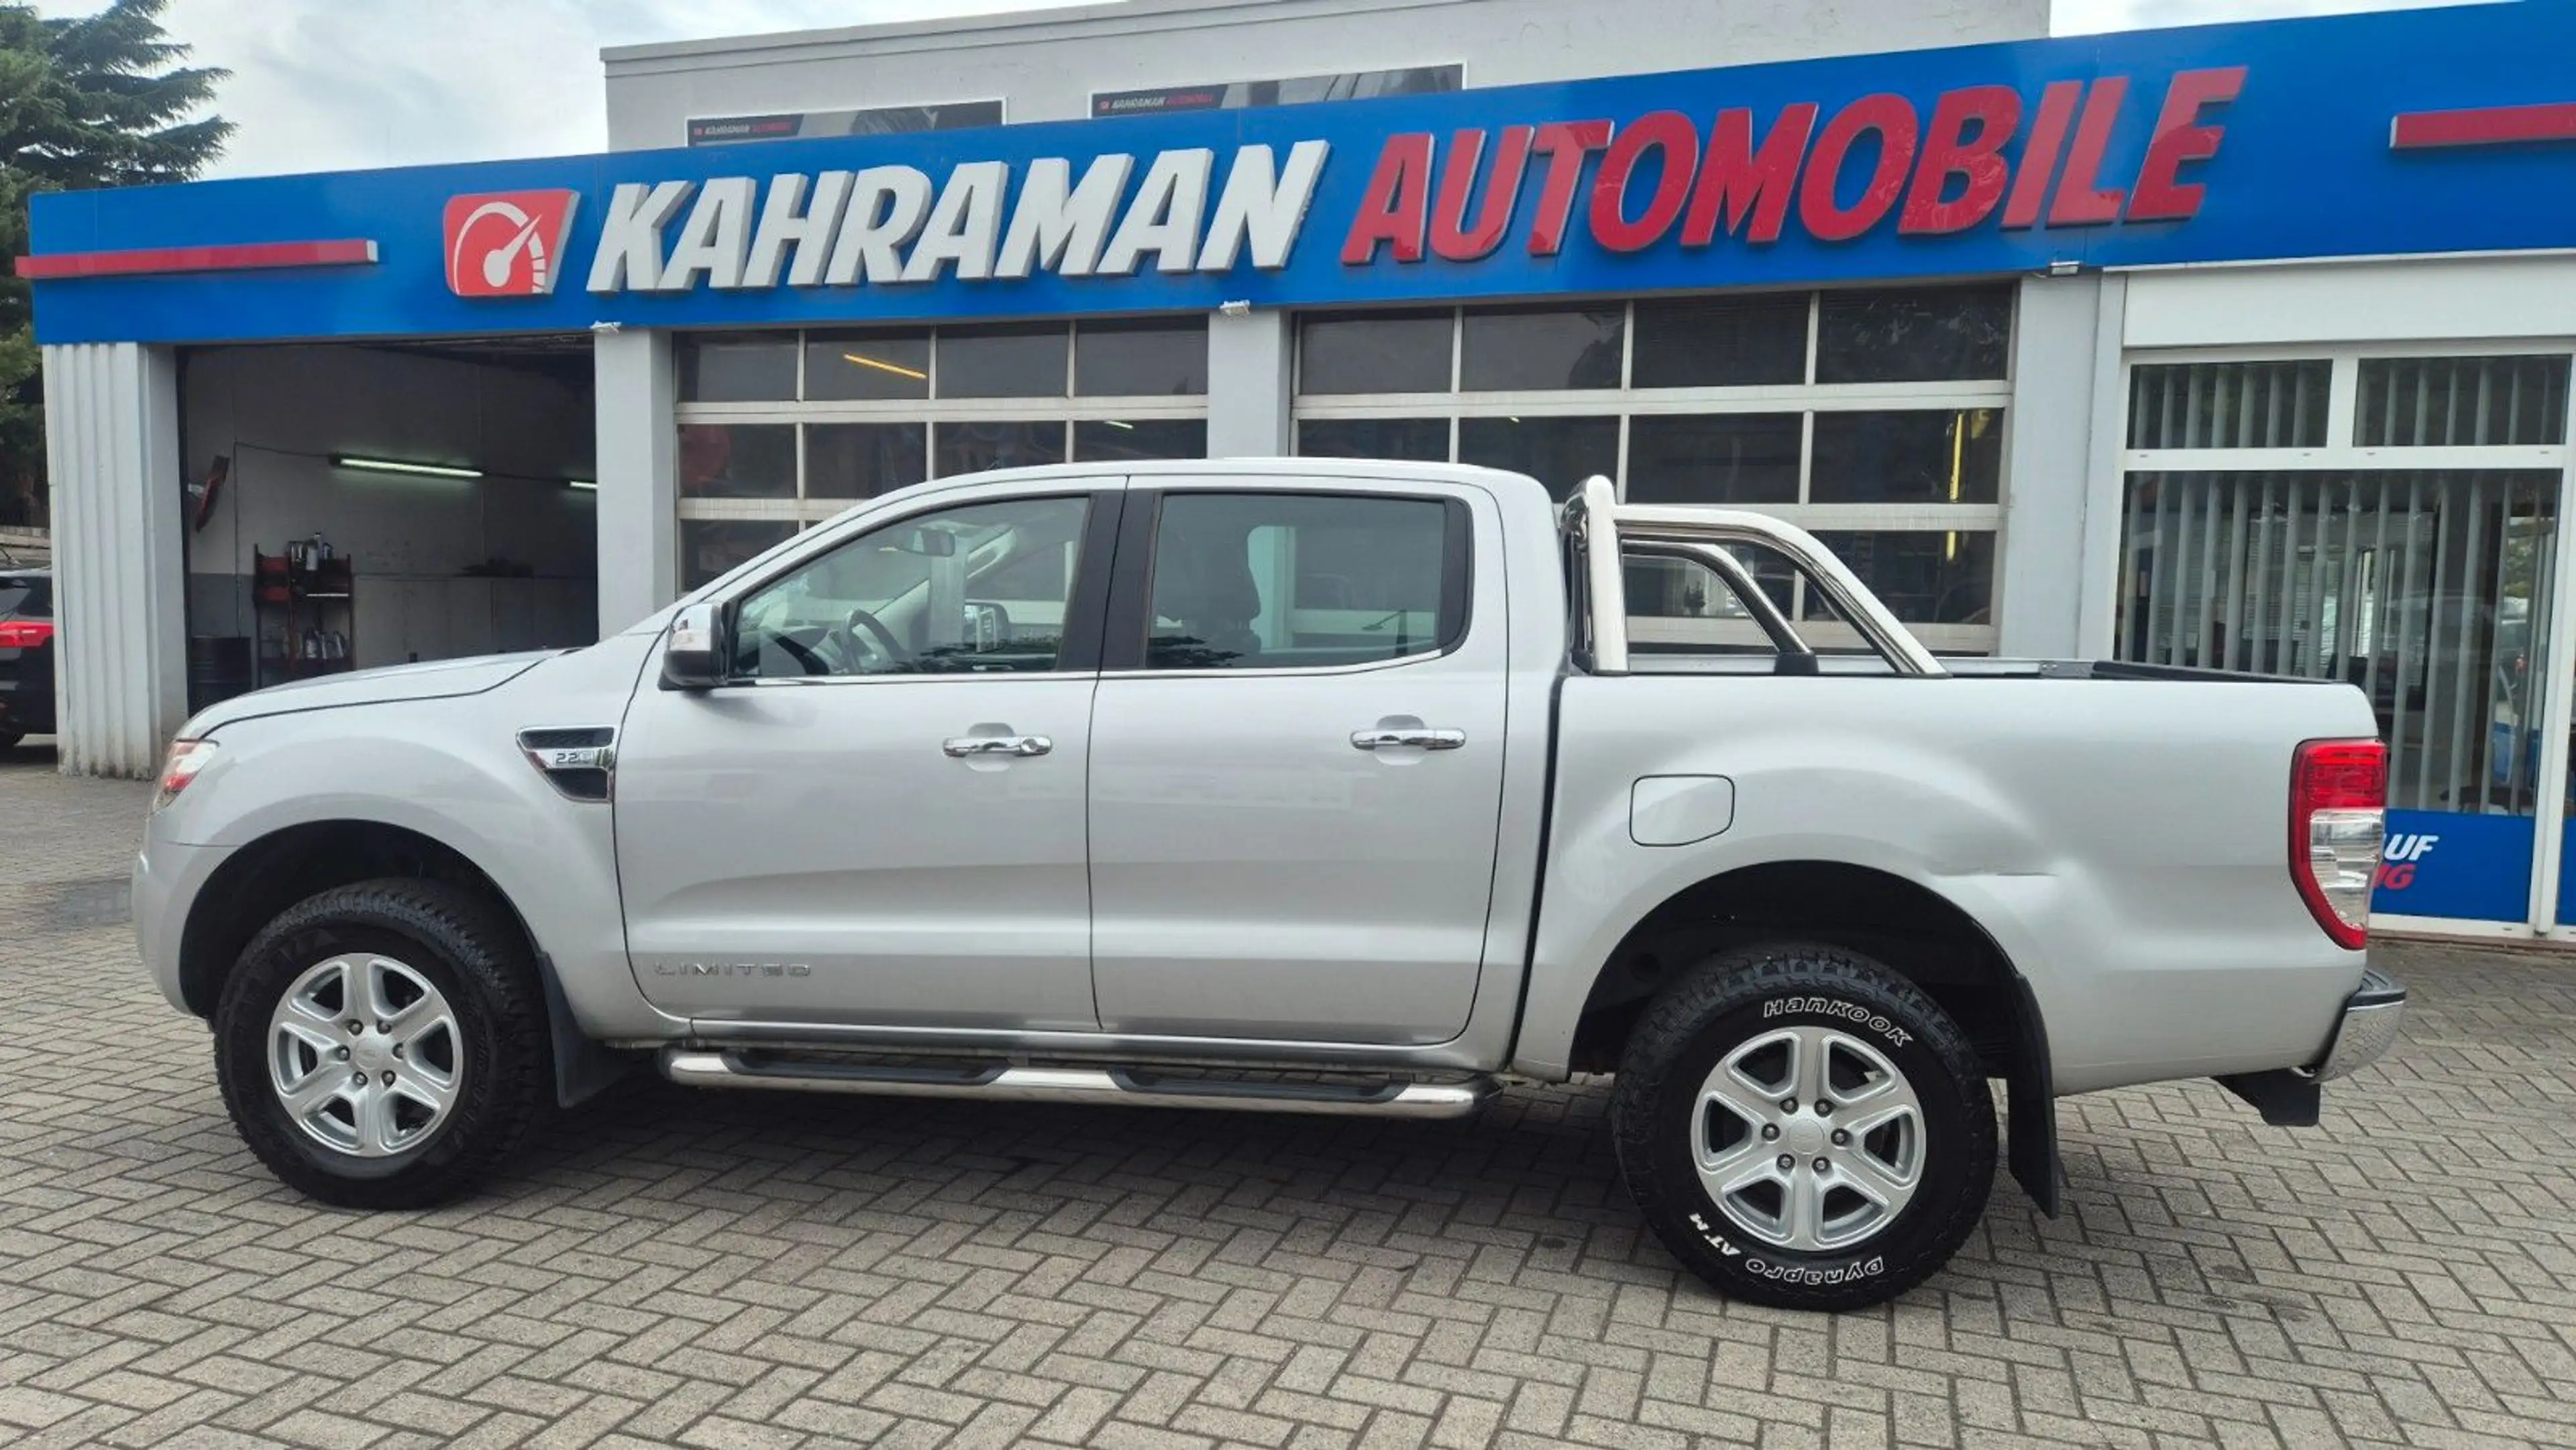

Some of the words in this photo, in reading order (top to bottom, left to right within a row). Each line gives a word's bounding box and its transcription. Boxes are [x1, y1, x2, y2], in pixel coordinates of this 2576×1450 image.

[586, 139, 1331, 293] KAHRAMAN
[1341, 66, 2249, 266] AUTOMOBILE
[2383, 833, 2440, 860] UF
[653, 962, 812, 977] LIMITED
